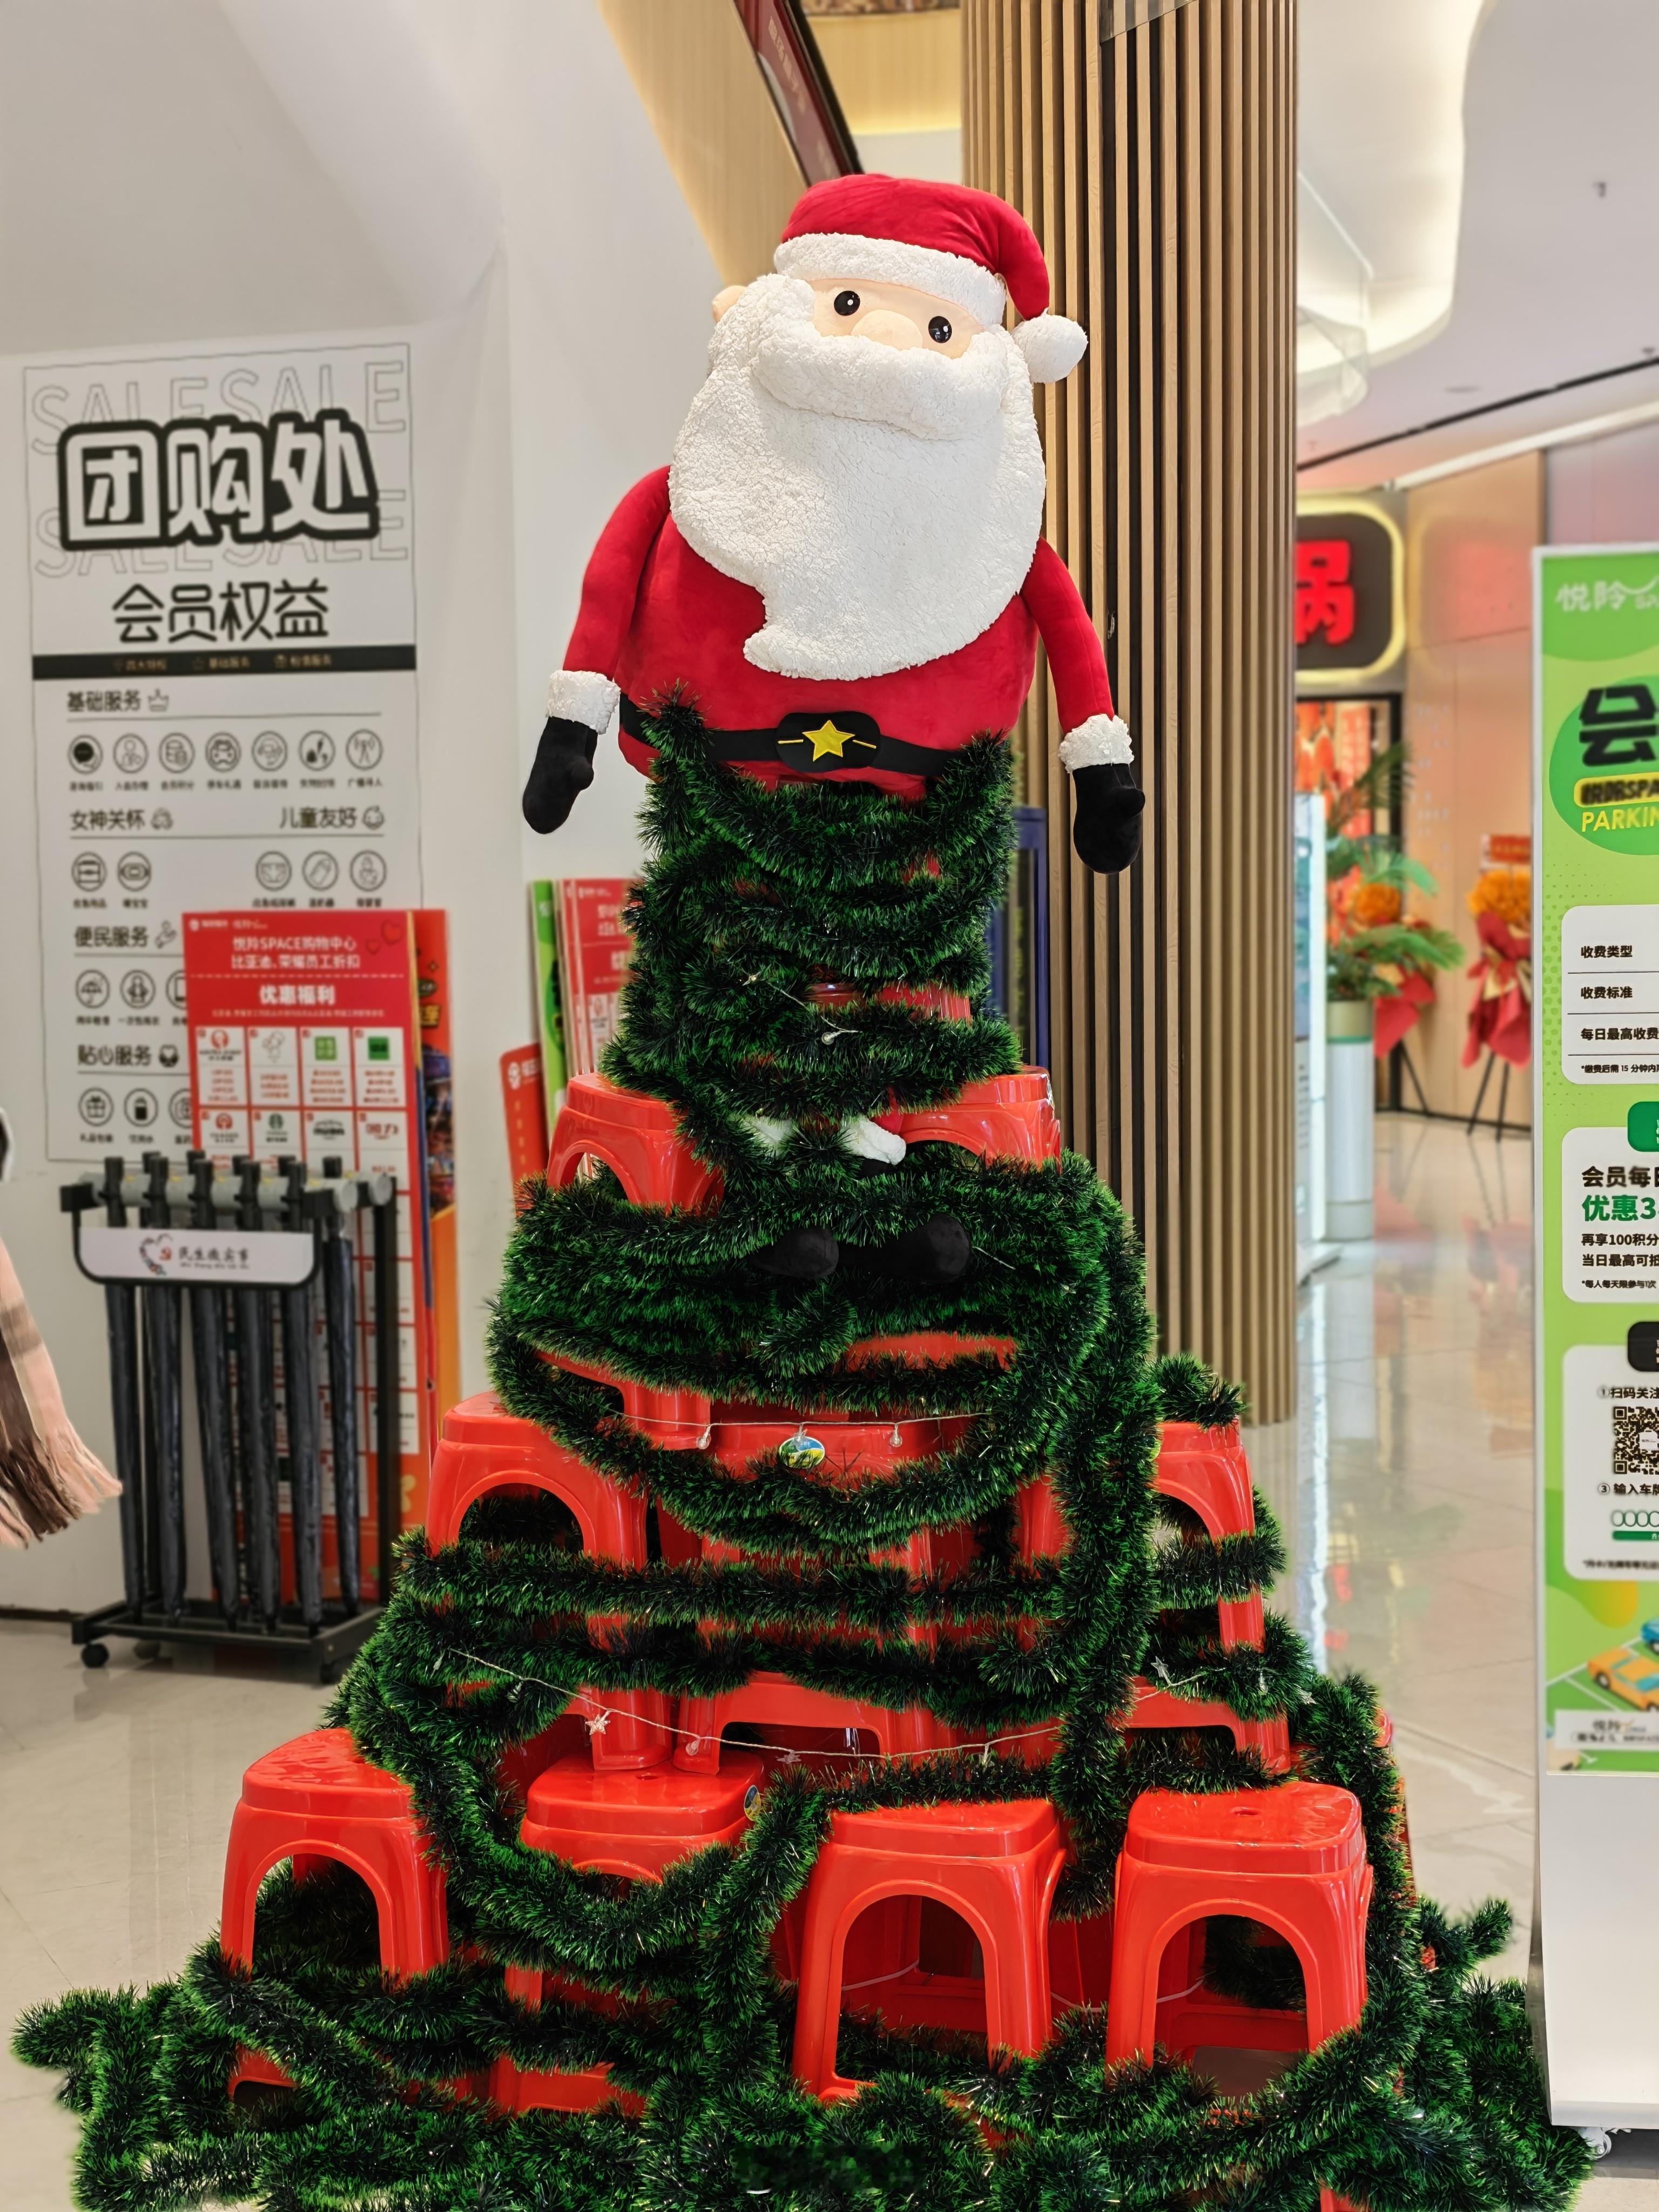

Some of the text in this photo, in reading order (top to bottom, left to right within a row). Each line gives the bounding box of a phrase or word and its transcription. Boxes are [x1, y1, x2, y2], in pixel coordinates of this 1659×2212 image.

[58, 409, 379, 551] 团购处
[112, 578, 328, 643] 会员权益
[67, 689, 141, 712] 基础服务
[70, 807, 356, 831] 女神关怀 儿童友好
[74, 926, 149, 948] 便民服务
[1580, 945, 1633, 959] 收费类型
[259, 983, 336, 1006] 优惠福利
[1580, 986, 1633, 999] 收费标准
[1580, 1027, 1659, 1041] 每日最高收费
[77, 1044, 151, 1067] 贴心服务
